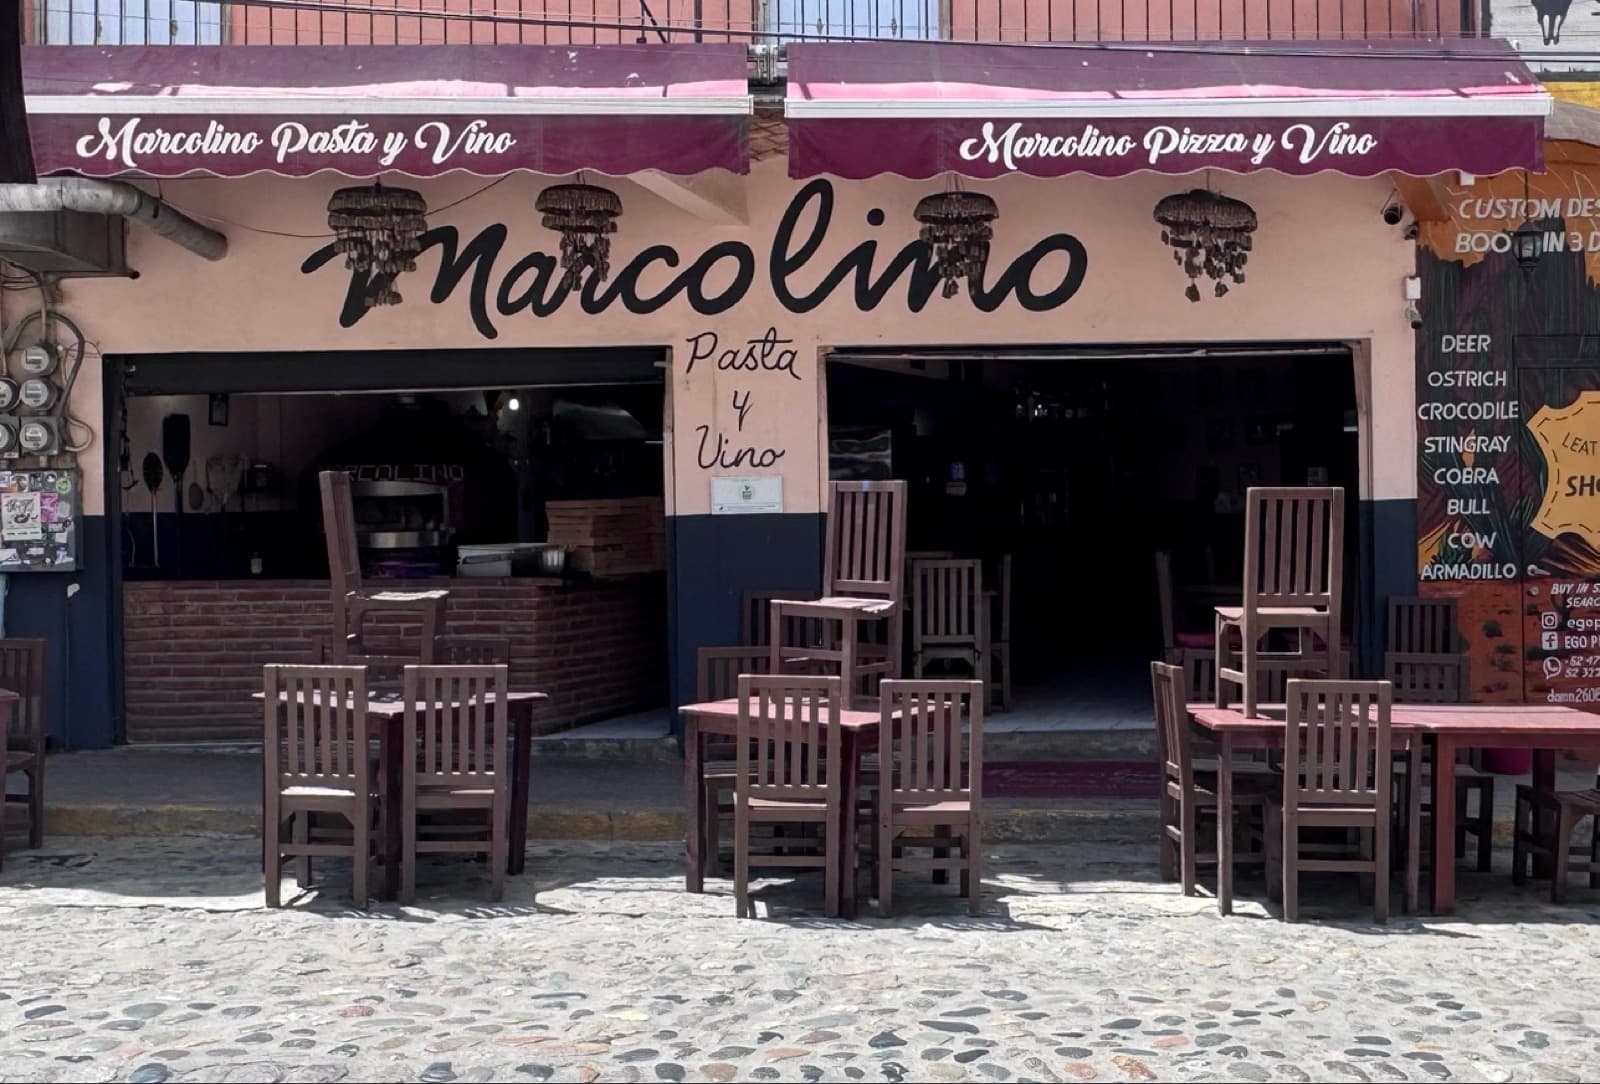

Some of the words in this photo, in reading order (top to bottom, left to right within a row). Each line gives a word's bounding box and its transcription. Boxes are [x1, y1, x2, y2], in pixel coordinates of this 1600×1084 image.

[76, 117, 263, 167] Marcolino
[271, 120, 379, 163] Pasta
[379, 132, 408, 166] y
[414, 120, 516, 164] Vino
[959, 121, 1137, 170] Marcolino
[1143, 125, 1248, 164] Pizza
[1250, 133, 1275, 165] y
[1281, 122, 1377, 164] Vino
[1459, 198, 1561, 218] CUSTOM
[1455, 231, 1514, 253] BOO
[1542, 231, 1565, 252] IN
[1569, 231, 1583, 252] 3
[302, 179, 1088, 339] Marcolino
[686, 326, 802, 380] Pasta
[1441, 334, 1491, 353] DEER
[1427, 370, 1508, 388] OSTRICH
[732, 390, 752, 432] y
[1418, 400, 1520, 421] CROCODILE
[696, 424, 785, 469] Vino
[1424, 435, 1512, 453] STINGRAY
[1434, 467, 1500, 485] COBRA
[1447, 498, 1491, 515] BULL
[1448, 532, 1497, 549] COW
[1420, 563, 1517, 581] ARMADILLO
[1550, 583, 1574, 595] BUY
[1565, 635, 1588, 649] EGO
